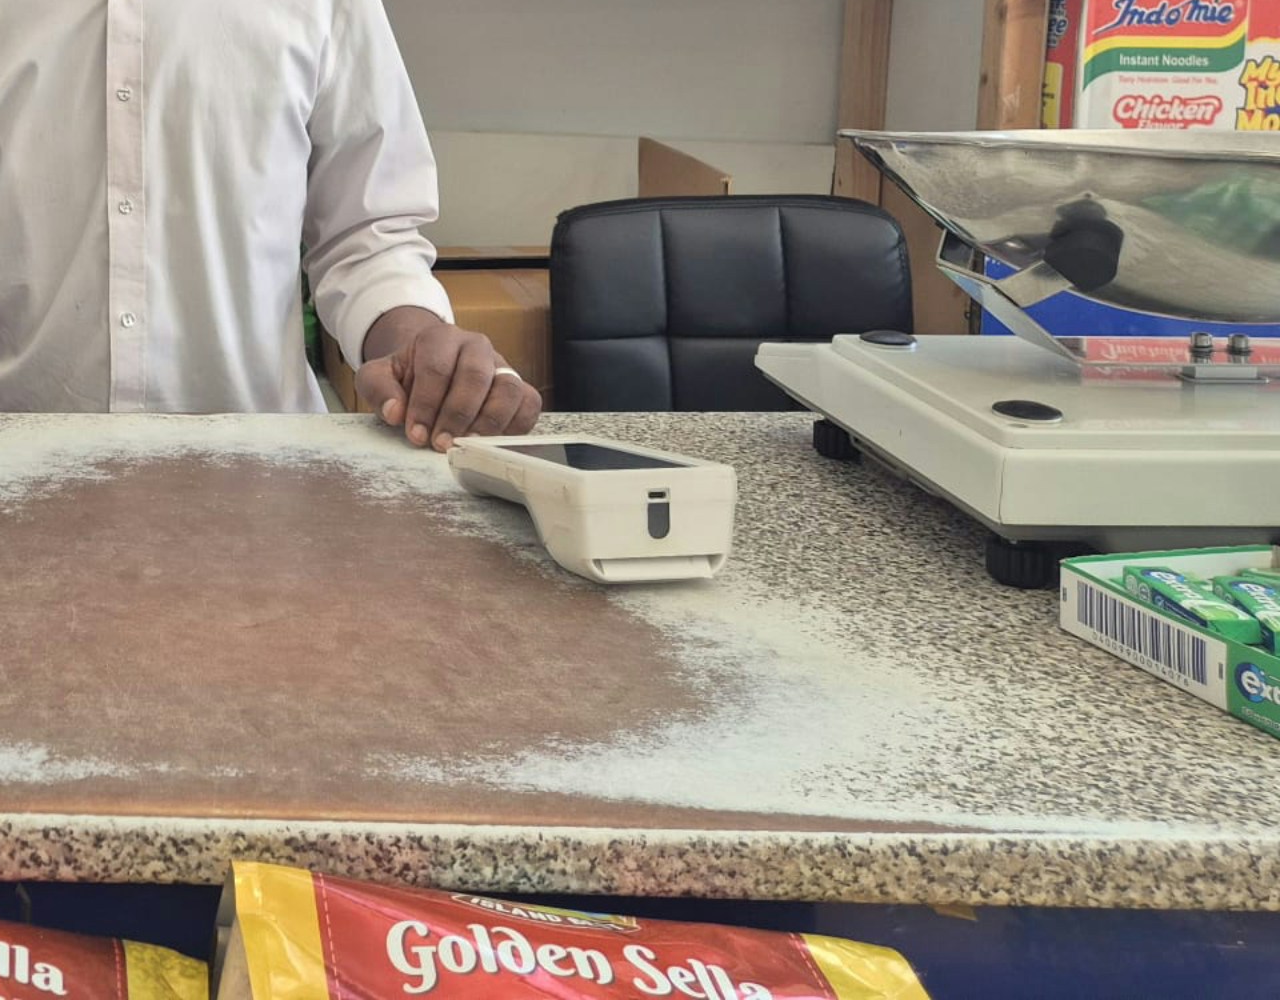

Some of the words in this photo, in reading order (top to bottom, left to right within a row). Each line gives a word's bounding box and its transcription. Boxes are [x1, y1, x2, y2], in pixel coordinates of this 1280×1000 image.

[1049, 17, 1068, 34] ee
[1119, 53, 1158, 67] Instant
[1162, 54, 1209, 68] Noodles
[1120, 96, 1216, 122] Chicken
[385, 919, 613, 995] Golden
[621, 944, 774, 1000] Sella
